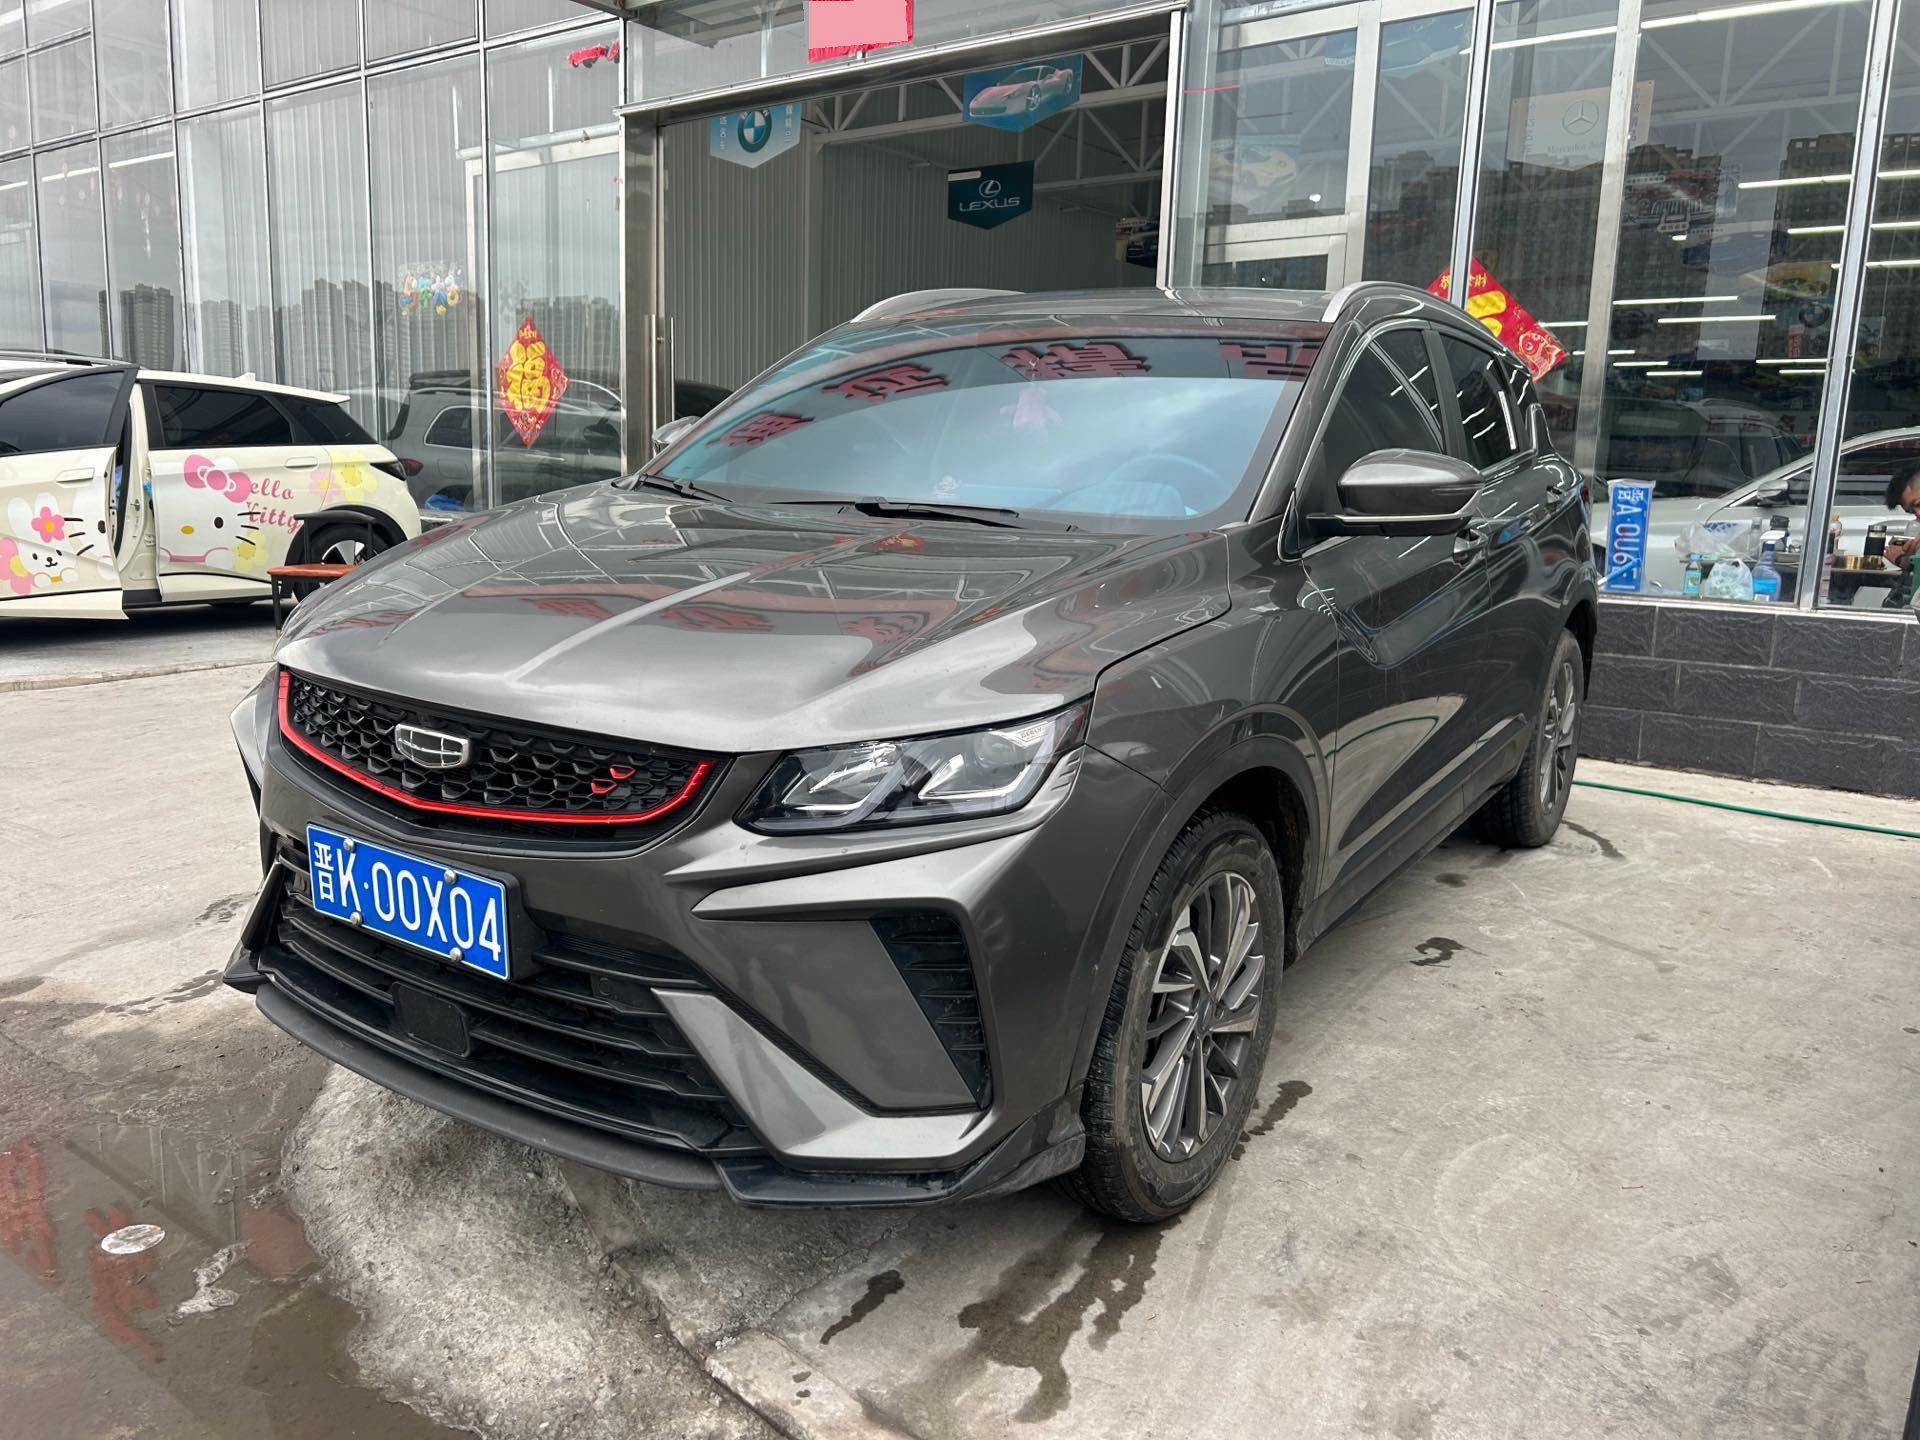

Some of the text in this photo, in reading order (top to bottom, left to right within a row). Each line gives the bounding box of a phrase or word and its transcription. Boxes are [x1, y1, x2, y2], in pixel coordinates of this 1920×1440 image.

[959, 196, 1021, 212] LEXUS
[506, 340, 551, 412] 福
[249, 477, 295, 500] ello
[313, 841, 502, 962] 晋K·00X04
